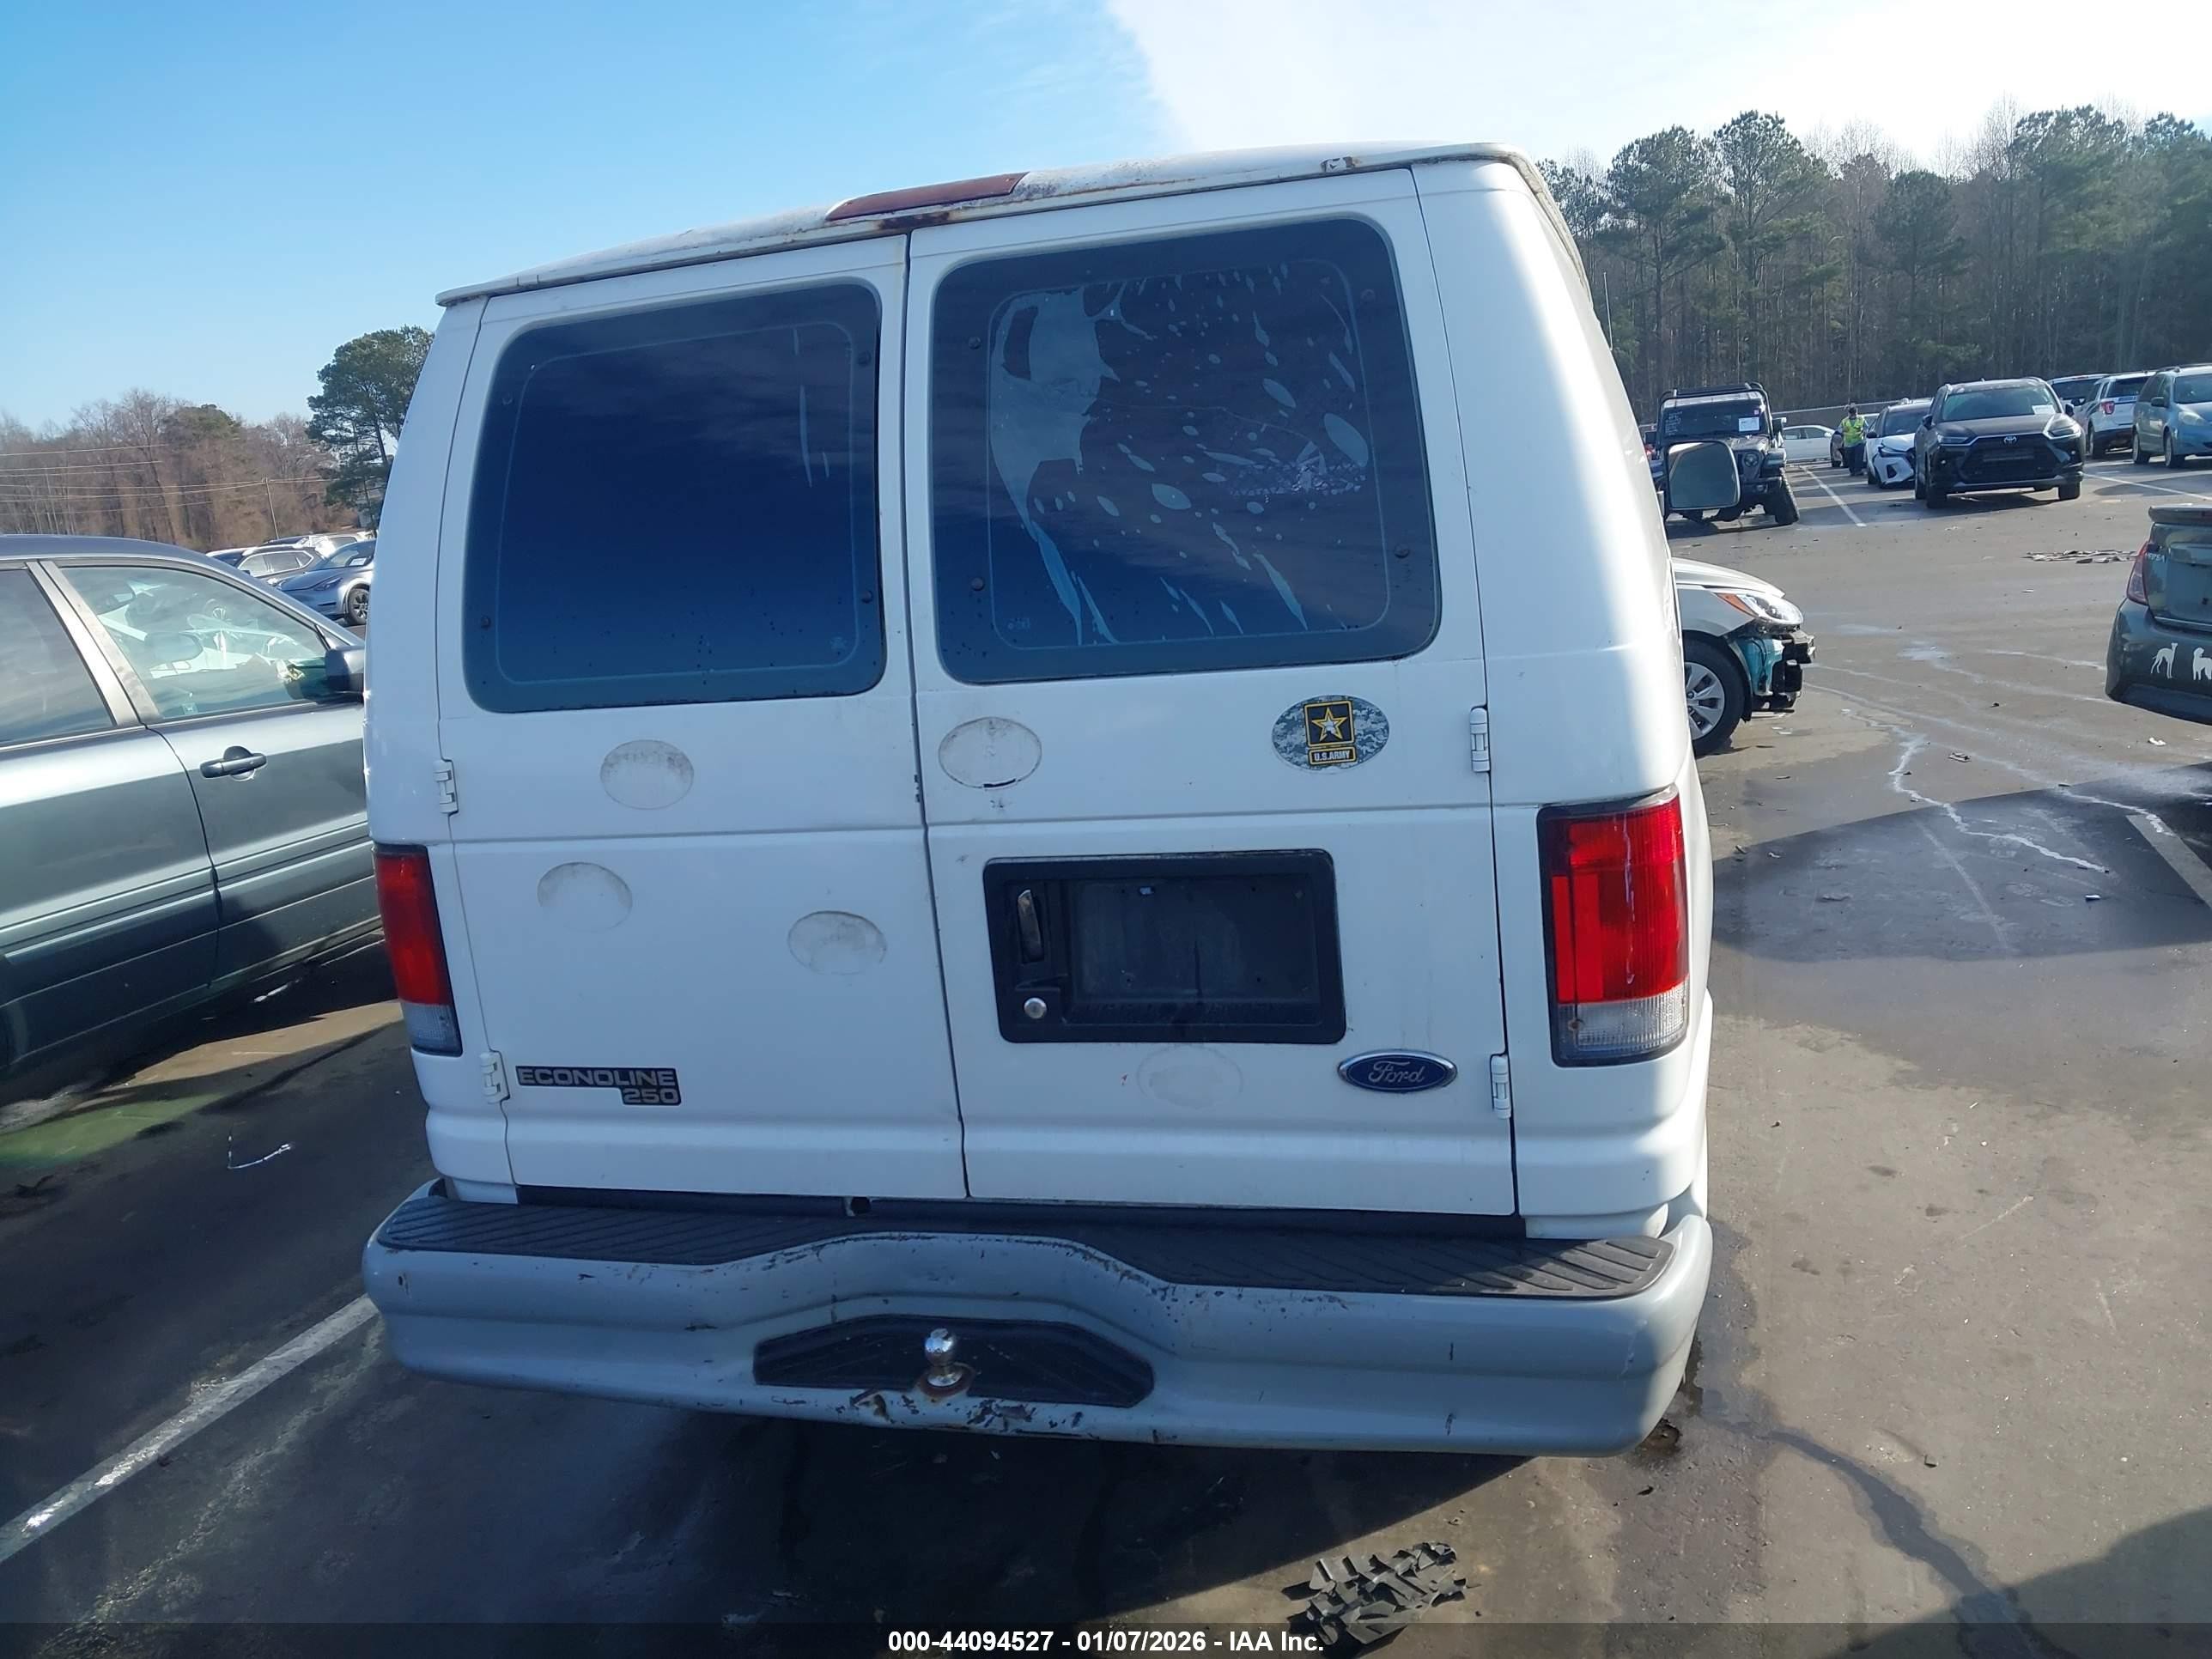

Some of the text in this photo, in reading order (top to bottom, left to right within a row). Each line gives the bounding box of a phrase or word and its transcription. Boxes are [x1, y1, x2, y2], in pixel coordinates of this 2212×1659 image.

[517, 1067, 677, 1087] ECONOLINE
[1368, 1060, 1425, 1084] Ford
[623, 1087, 679, 1104] 250
